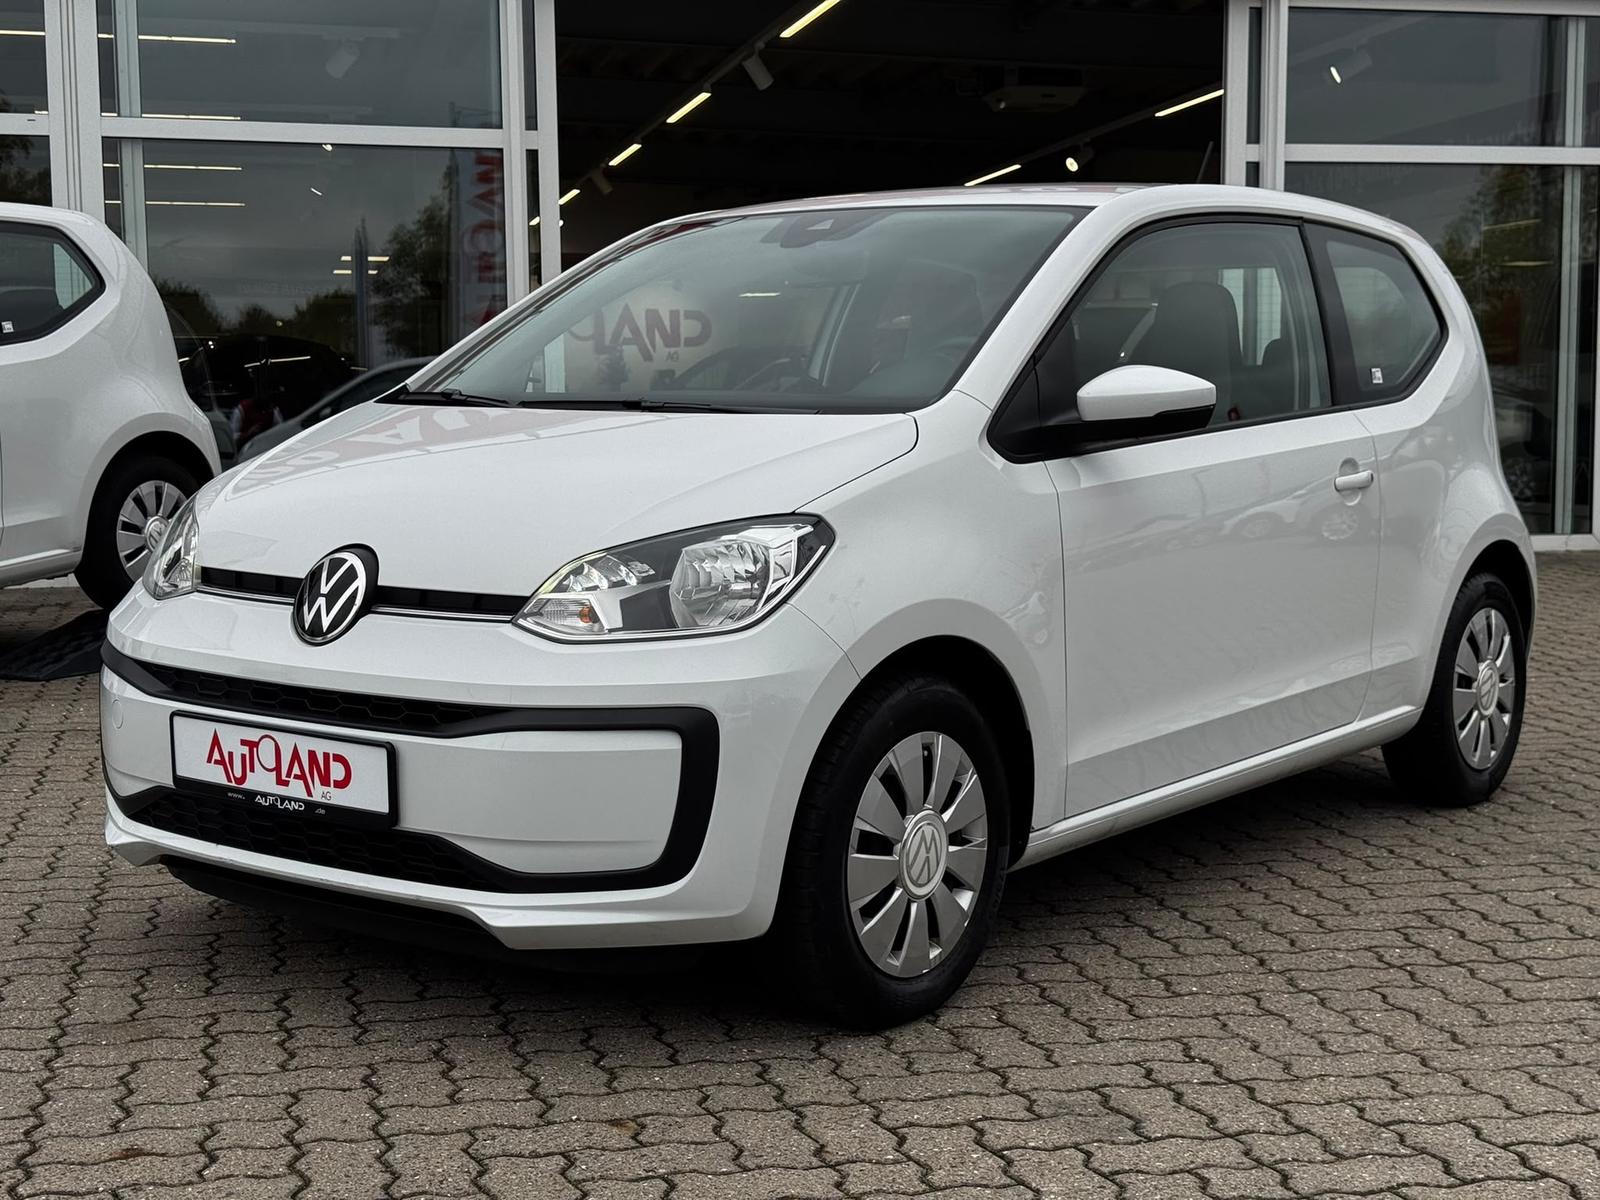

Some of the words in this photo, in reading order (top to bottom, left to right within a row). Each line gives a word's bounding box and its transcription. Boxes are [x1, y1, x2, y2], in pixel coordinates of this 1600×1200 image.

[206, 728, 352, 797] AUTOLAND
[254, 794, 305, 811] AUTOLAND
[321, 791, 332, 801] AG
